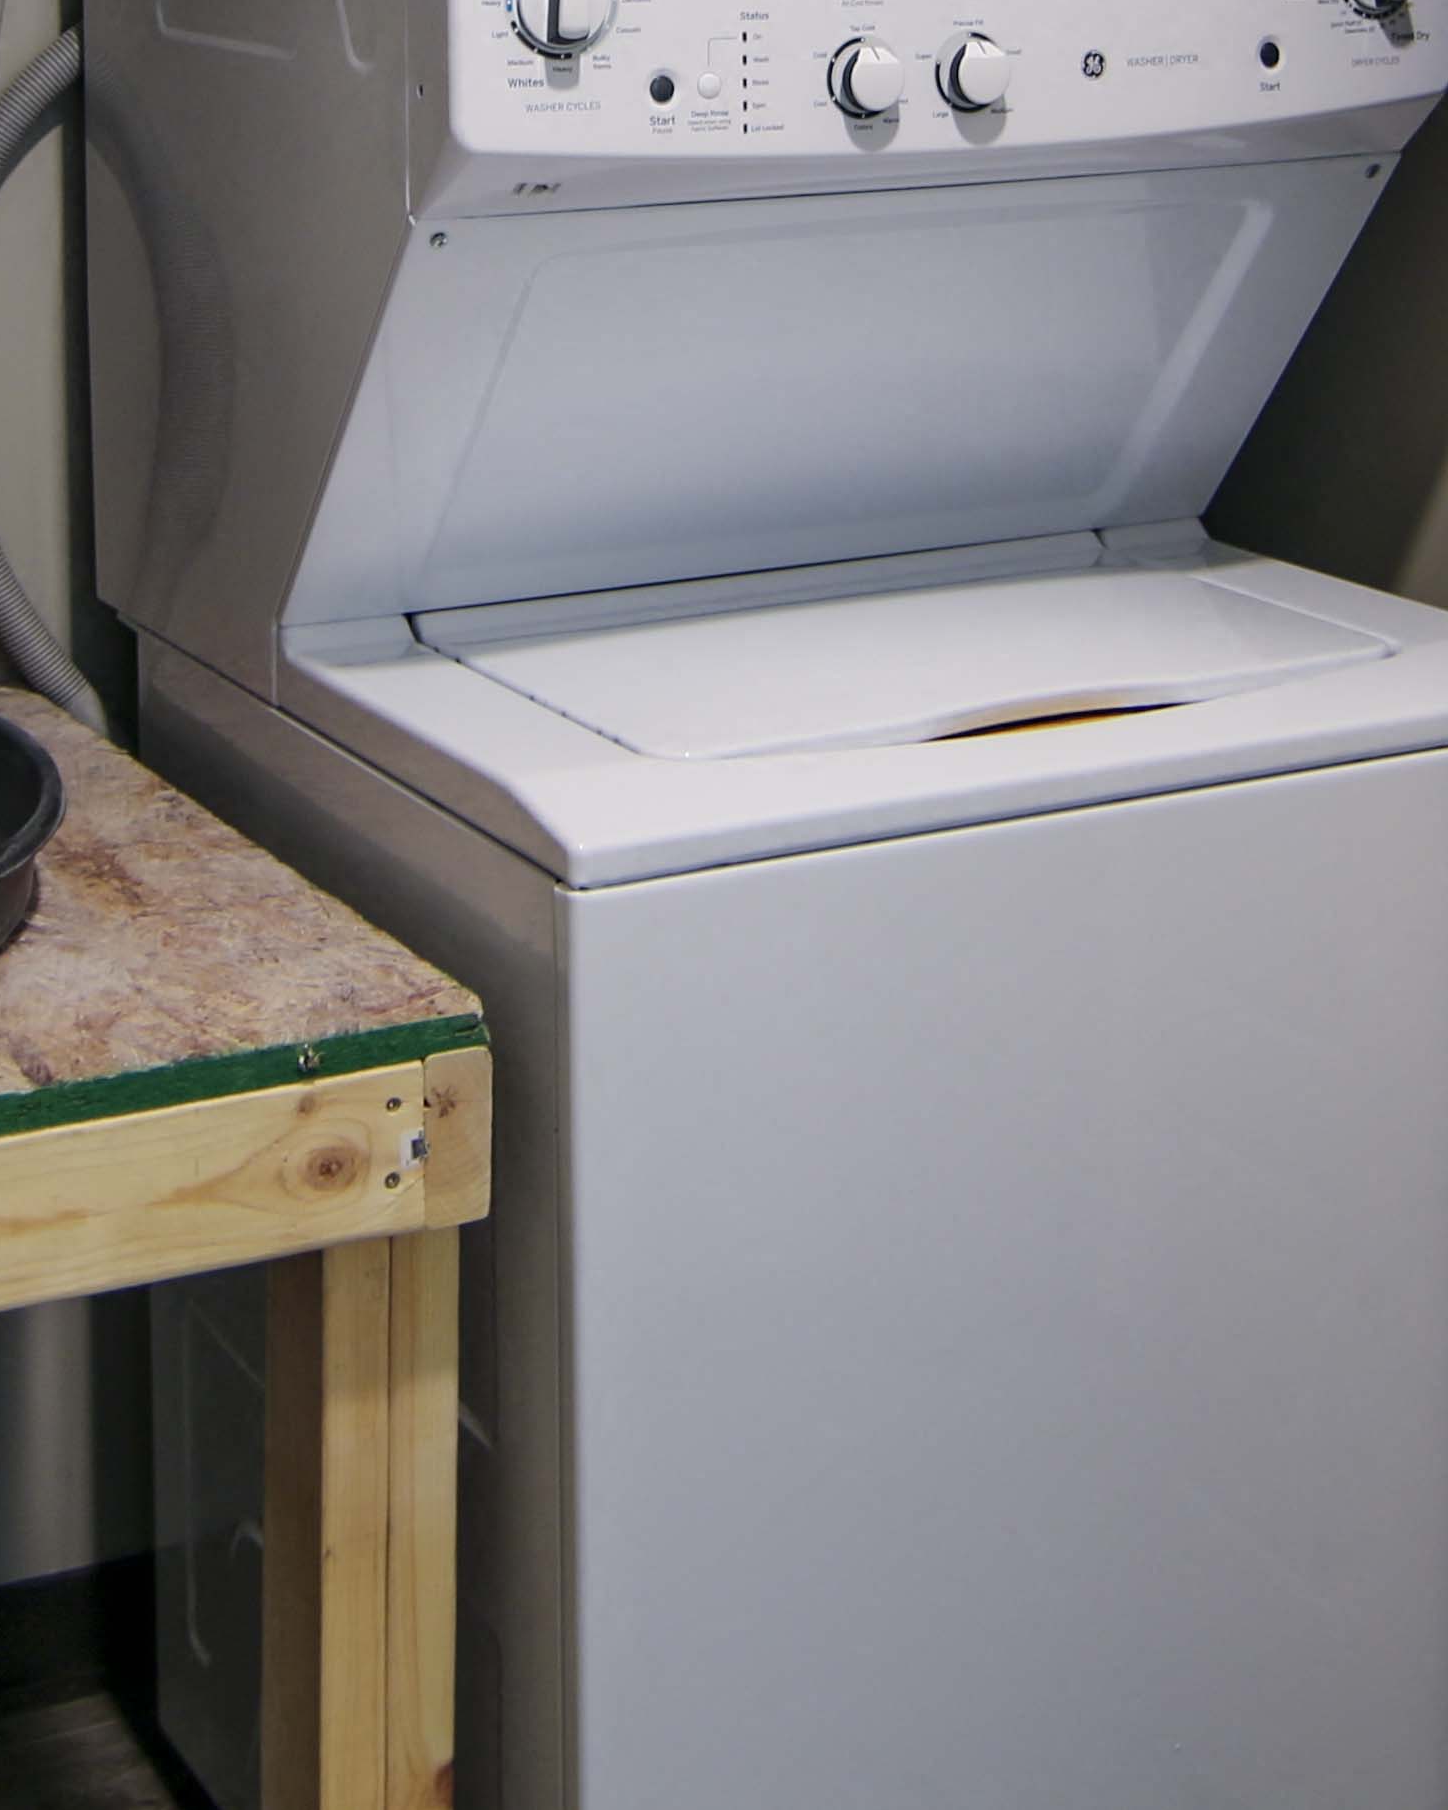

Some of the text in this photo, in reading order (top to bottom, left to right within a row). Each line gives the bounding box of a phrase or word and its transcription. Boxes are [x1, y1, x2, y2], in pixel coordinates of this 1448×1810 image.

[740, 12, 769, 20] Status
[1416, 32, 1429, 40] Dry
[507, 78, 545, 89] Whites
[1259, 82, 1281, 92] Start
[525, 101, 601, 113] WASHER CYCLES
[649, 115, 675, 126] Start
